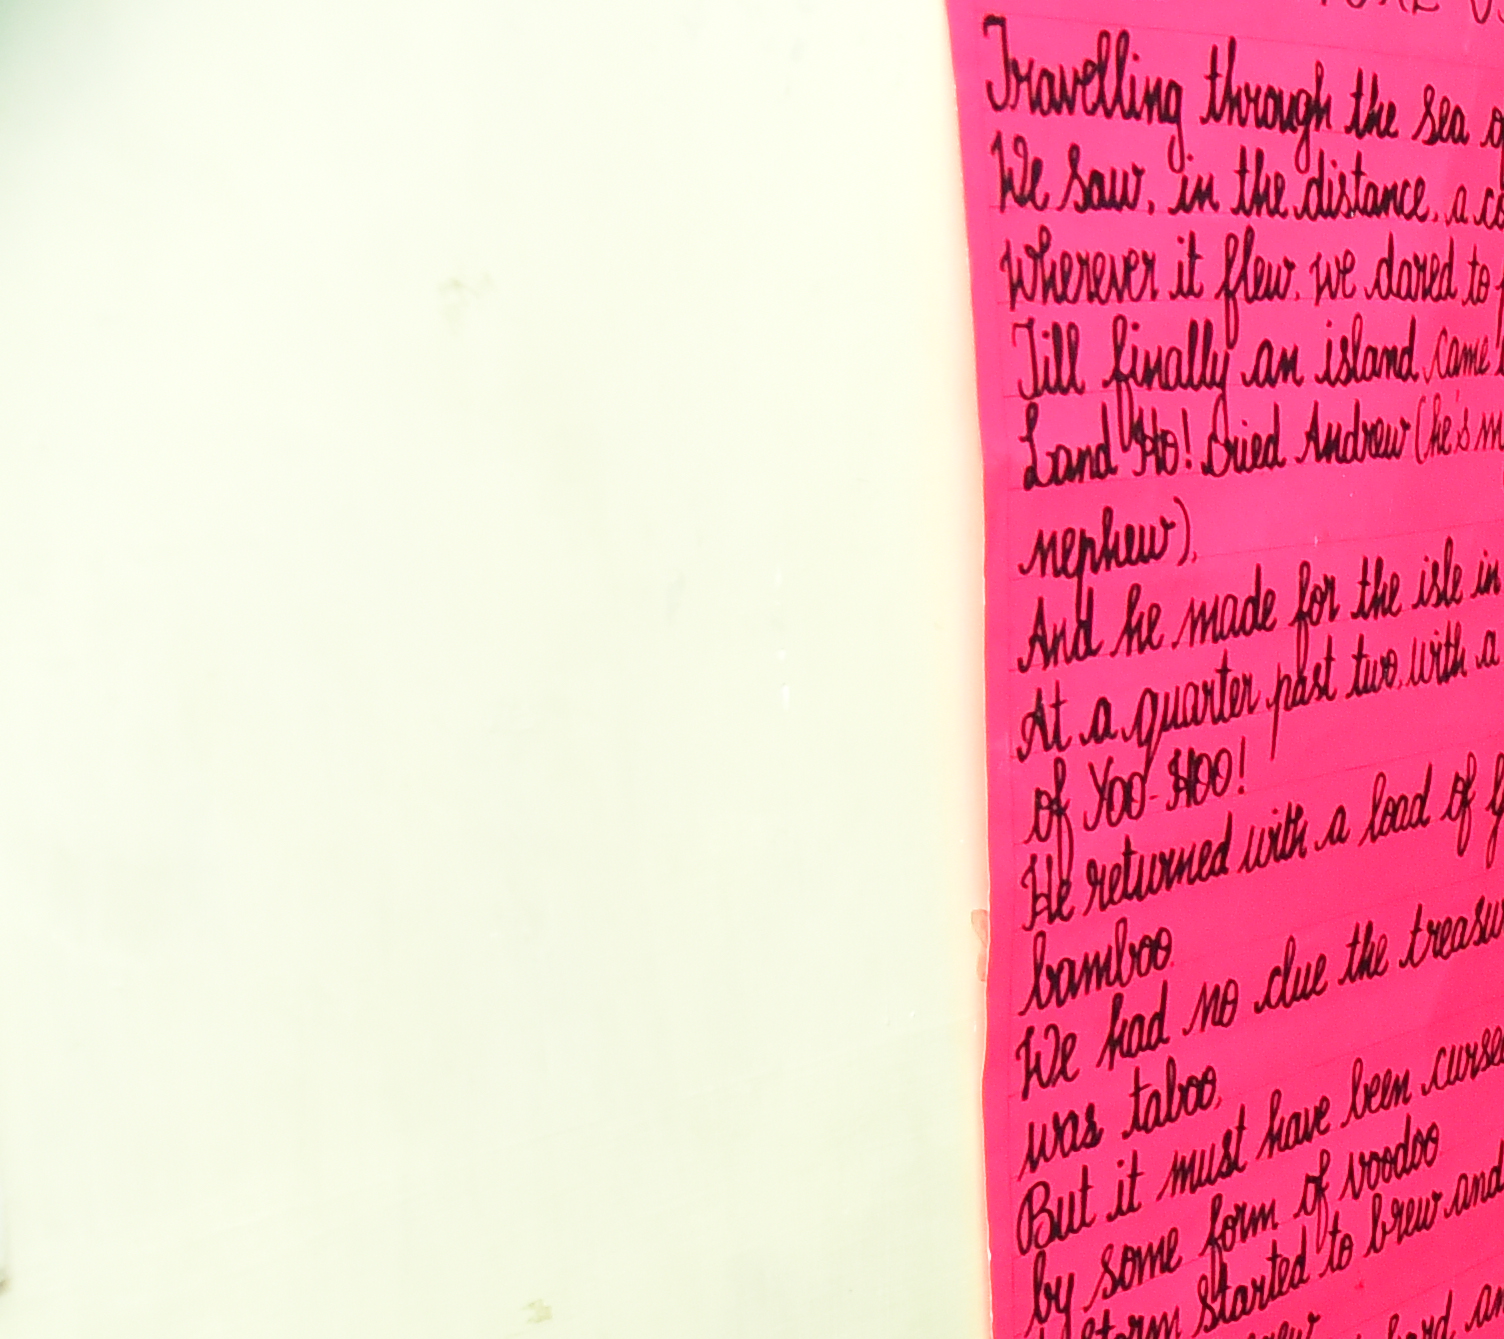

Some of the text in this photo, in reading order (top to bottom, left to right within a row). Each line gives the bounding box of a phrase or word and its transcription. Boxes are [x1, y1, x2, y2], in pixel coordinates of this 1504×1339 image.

[1199, 35, 1332, 174] through
[1344, 67, 1399, 139] the
[990, 129, 1050, 214] We
[1168, 153, 1220, 215] in
[1230, 144, 1289, 218] the
[1444, 184, 1468, 227] a
[1170, 230, 1204, 299] it
[1364, 231, 1457, 302] dared
[1461, 243, 1491, 307] to
[1012, 317, 1086, 400] Till
[1102, 314, 1231, 452] finally
[1241, 338, 1304, 388] an
[1315, 312, 1419, 388] island
[1422, 327, 1490, 384] came
[1021, 853, 1076, 932] He
[1083, 811, 1230, 916] returned
[1237, 801, 1308, 874] with
[1315, 805, 1351, 851] a
[1358, 761, 1431, 847] load
[1440, 750, 1477, 857] of
